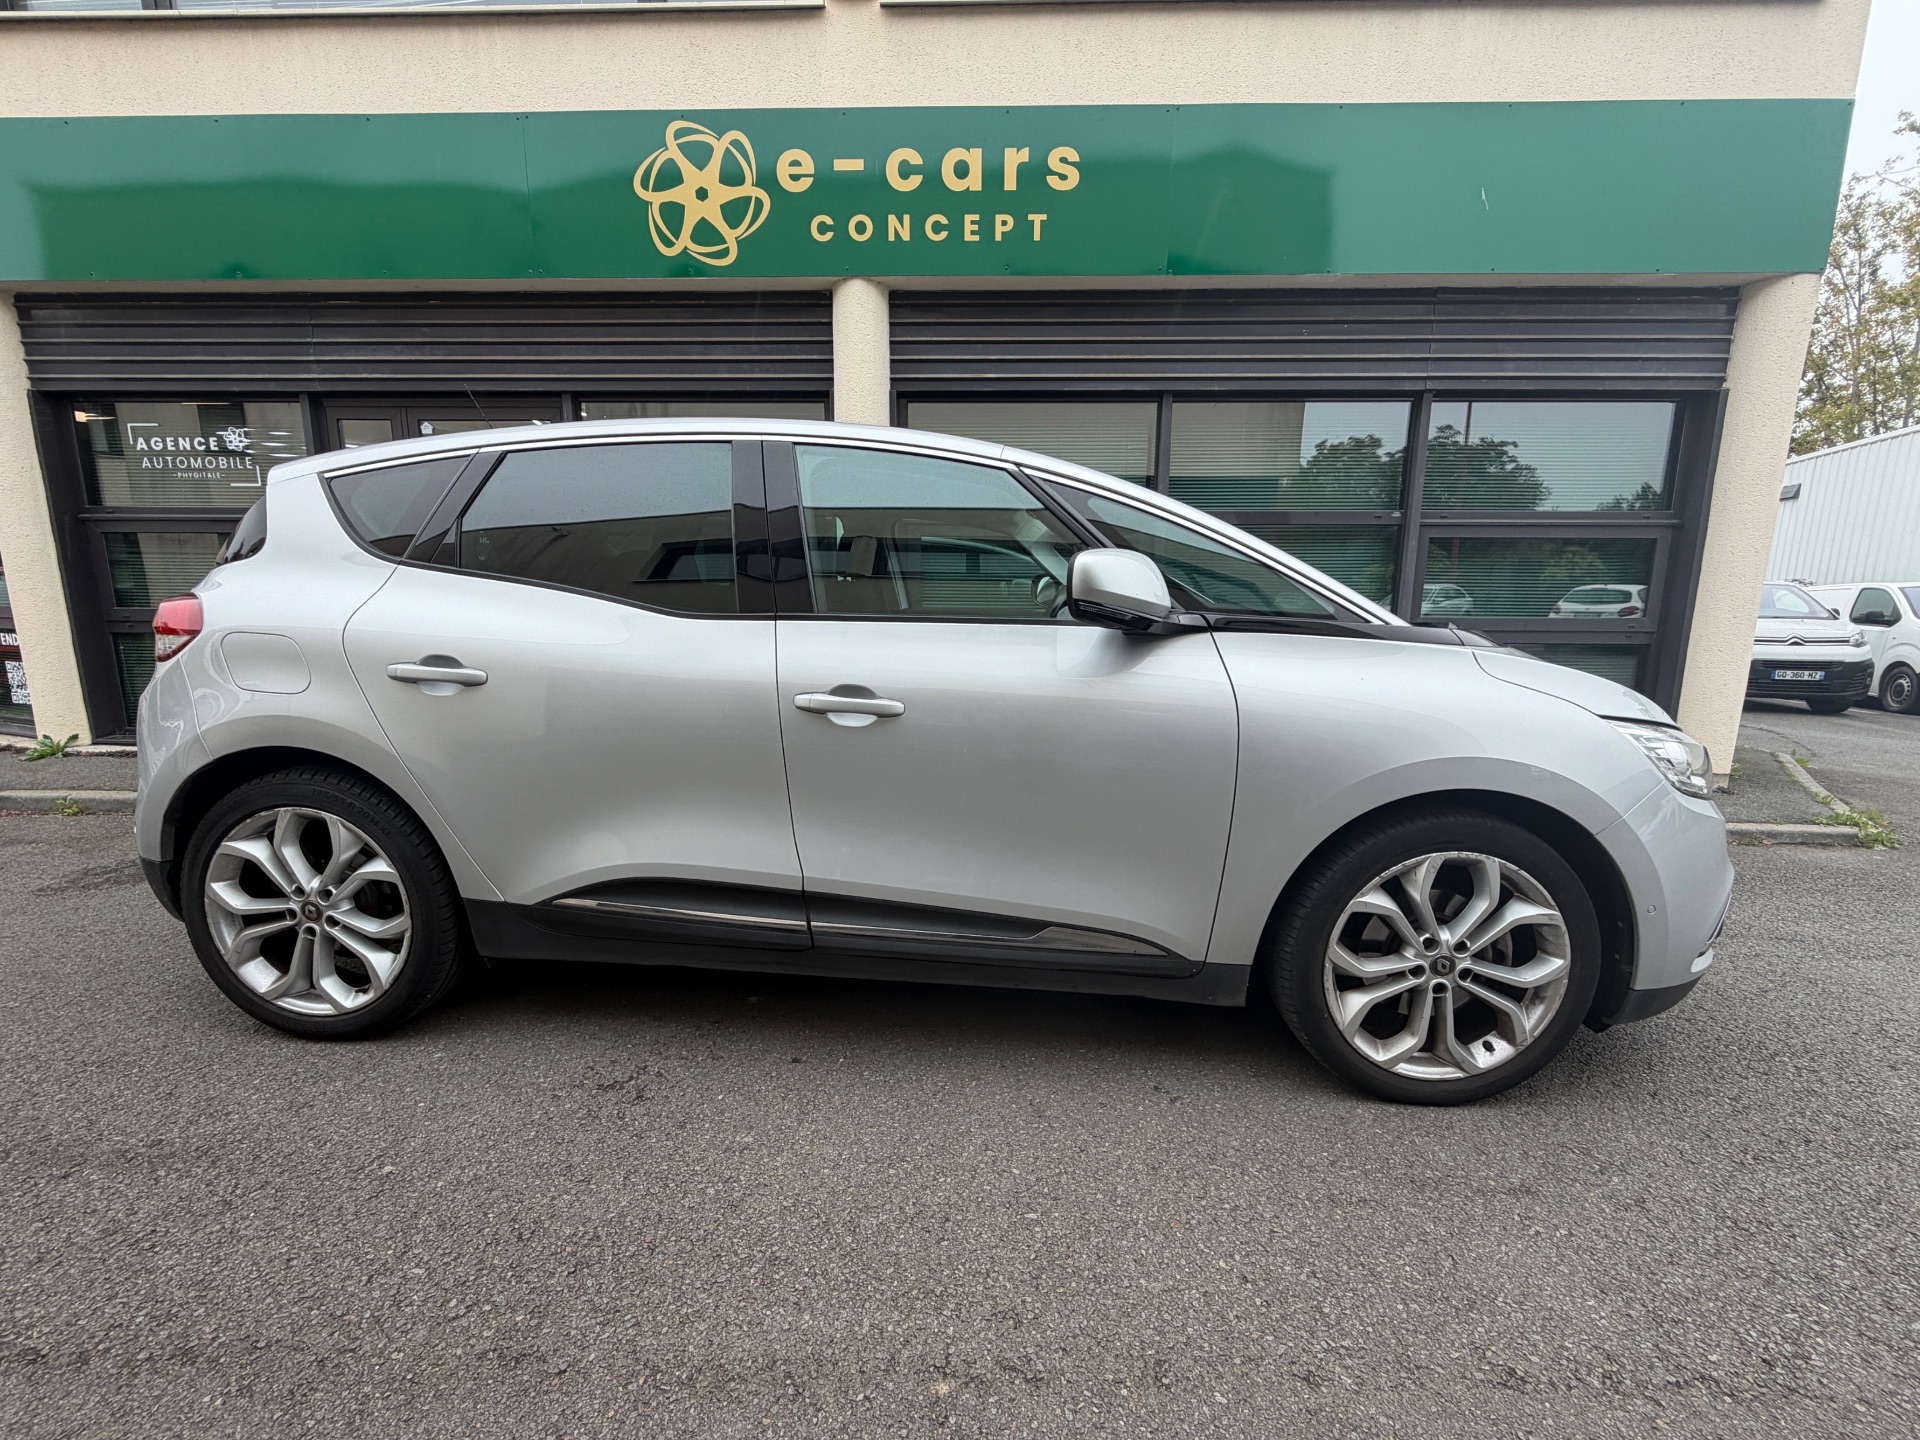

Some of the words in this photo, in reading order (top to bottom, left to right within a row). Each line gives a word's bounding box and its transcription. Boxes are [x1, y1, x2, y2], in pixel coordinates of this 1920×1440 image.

[810, 213, 1048, 243] CONCEPT
[136, 436, 219, 451] AGENCE
[142, 456, 253, 469] AUTOMOBILE
